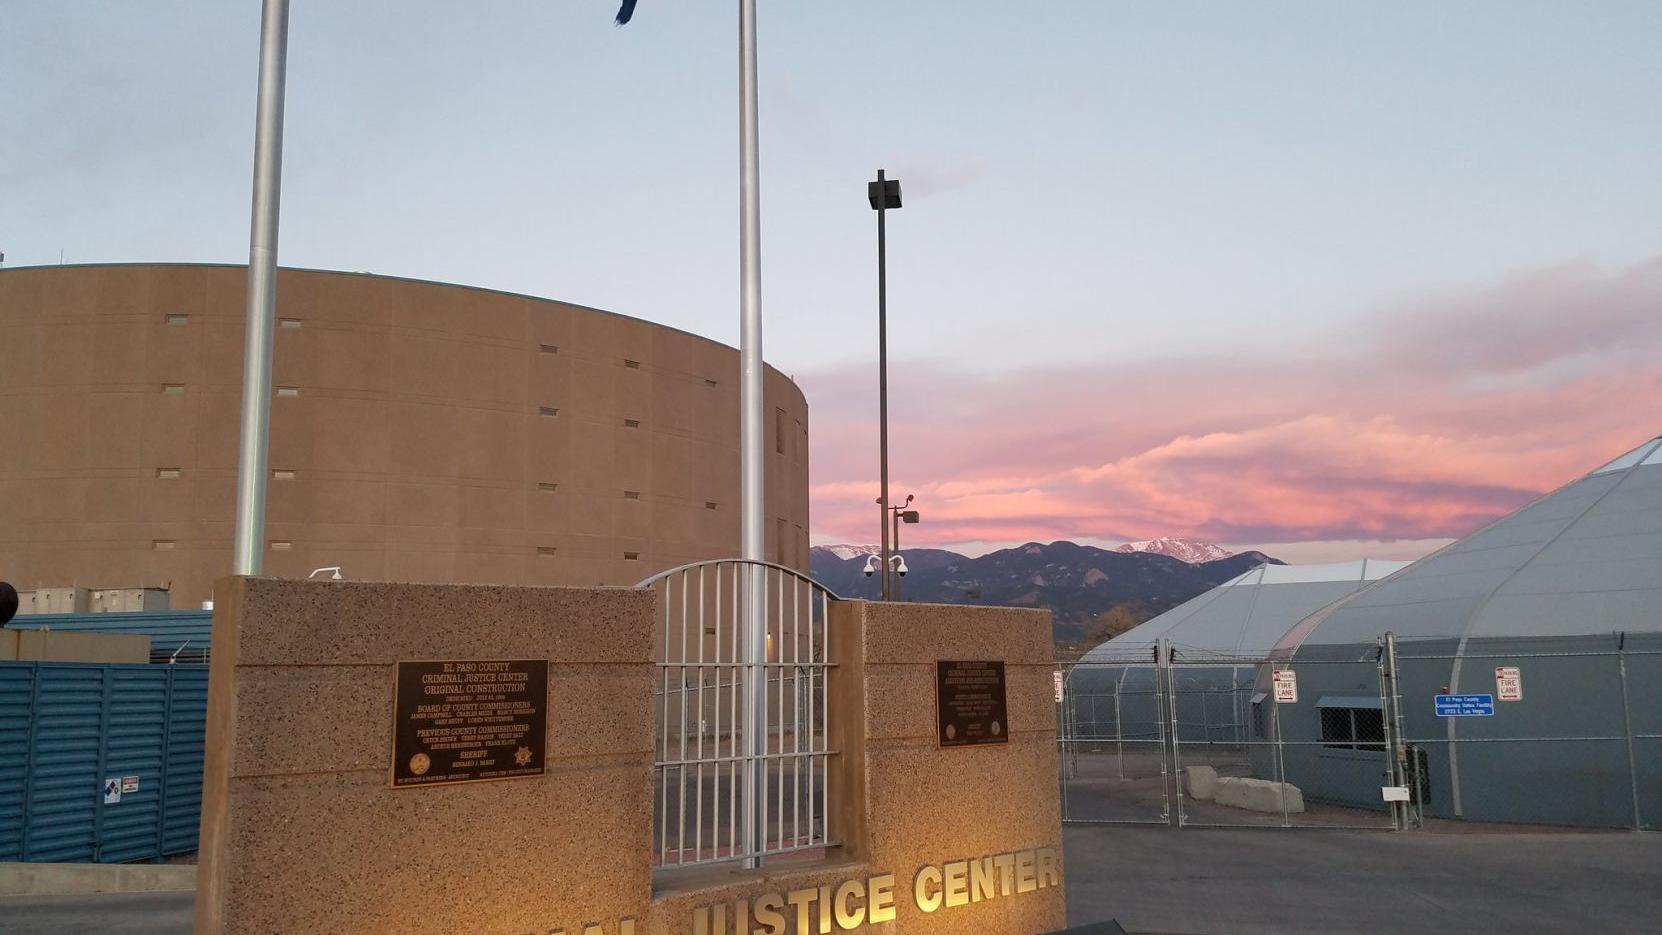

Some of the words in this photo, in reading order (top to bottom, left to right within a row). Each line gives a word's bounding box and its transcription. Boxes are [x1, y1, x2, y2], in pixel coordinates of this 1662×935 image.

[443, 663, 455, 673] EL
[456, 663, 477, 672] PASO
[479, 662, 510, 672] COUNTY
[422, 674, 463, 684] CRIMINAL
[464, 673, 497, 682] JUSTICE
[498, 672, 528, 681] CENTER
[424, 685, 464, 695] ORIGINAL
[466, 683, 526, 694] CONSTRUCTION
[417, 705, 440, 713] BOARD
[441, 704, 451, 712] OF
[452, 703, 479, 711] COUNTY
[479, 701, 530, 710] COMMISSIONERS
[417, 728, 451, 738] PREVIOUS
[451, 727, 478, 735] COUNTY
[478, 724, 530, 733] COMMISSIONERS
[460, 750, 488, 759] SHERIFF
[693, 873, 896, 935] JUSTICE
[912, 848, 1061, 913] CENTER
